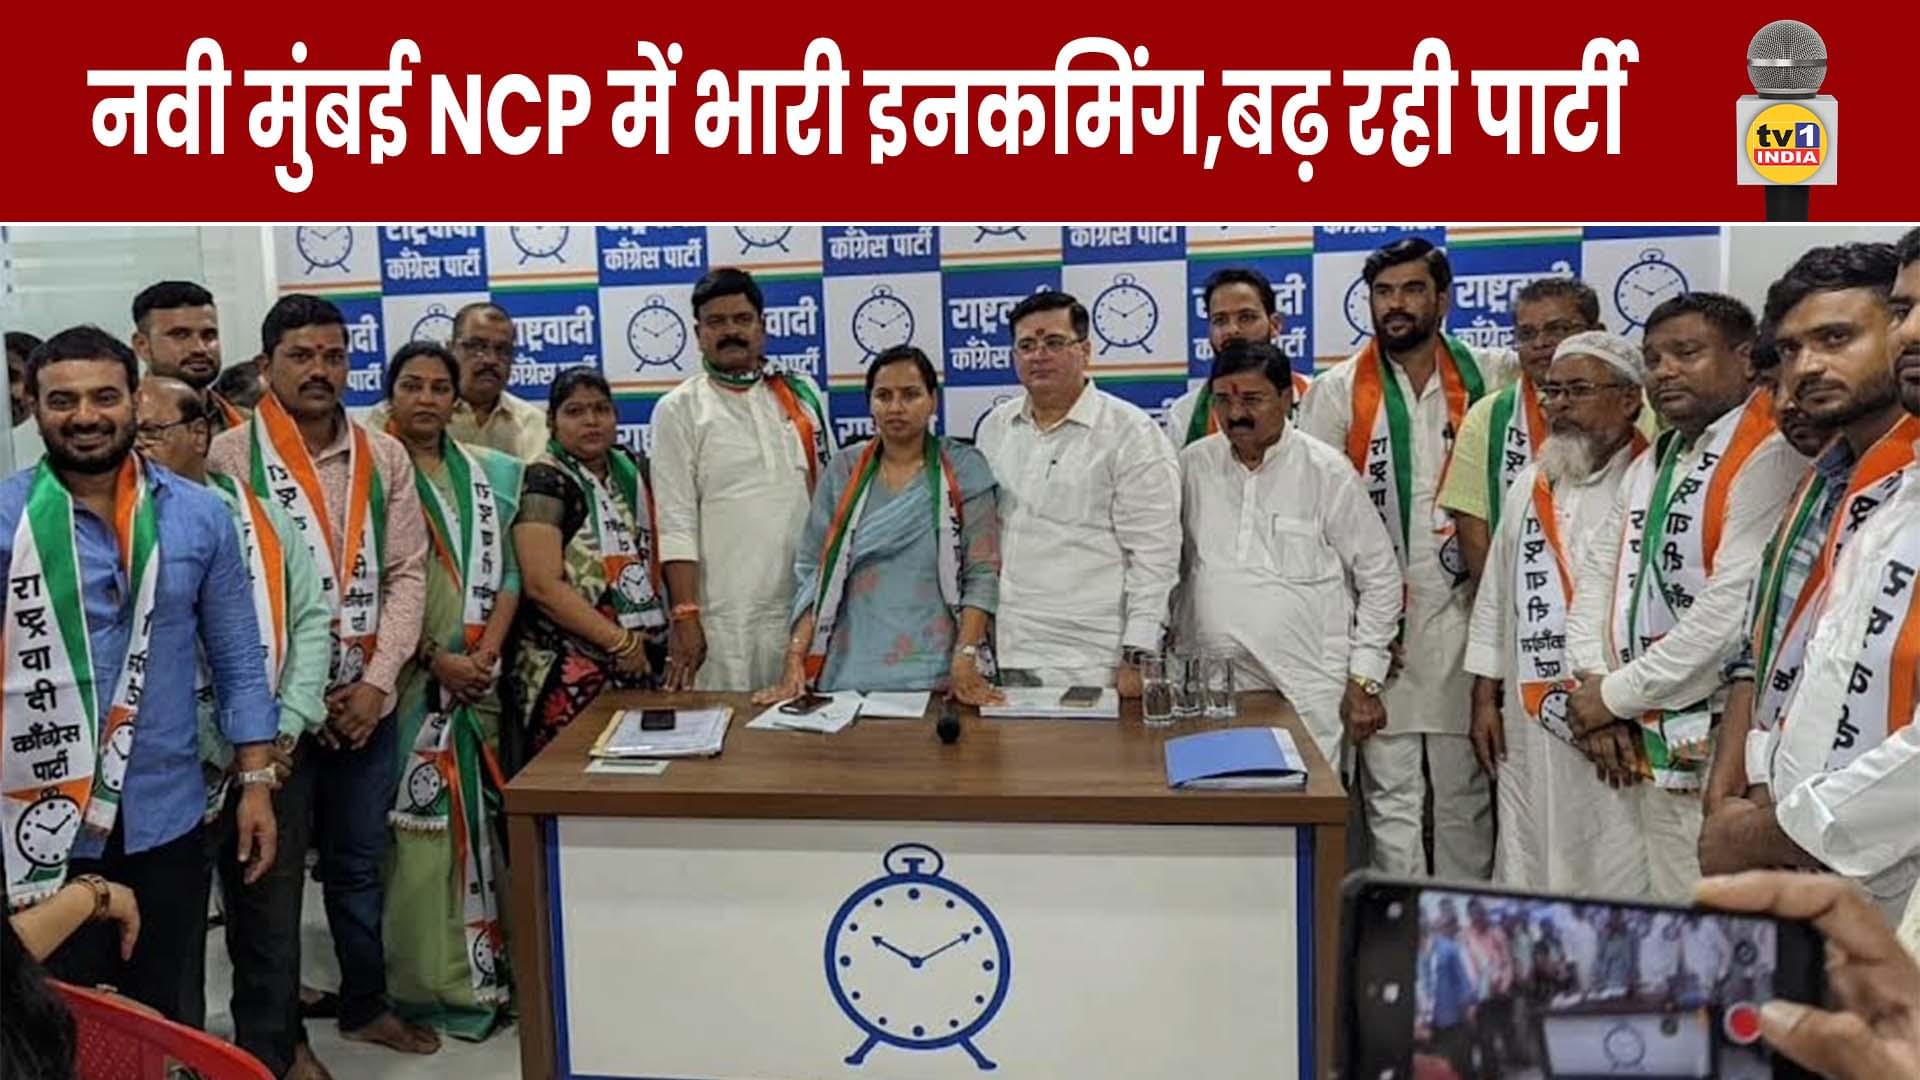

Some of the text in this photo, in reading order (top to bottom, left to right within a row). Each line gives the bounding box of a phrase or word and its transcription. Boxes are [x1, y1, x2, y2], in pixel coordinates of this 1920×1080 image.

[441, 248, 481, 277] पार्टी
[662, 237, 703, 268] पार्टी
[32, 749, 70, 781] पार्टी
